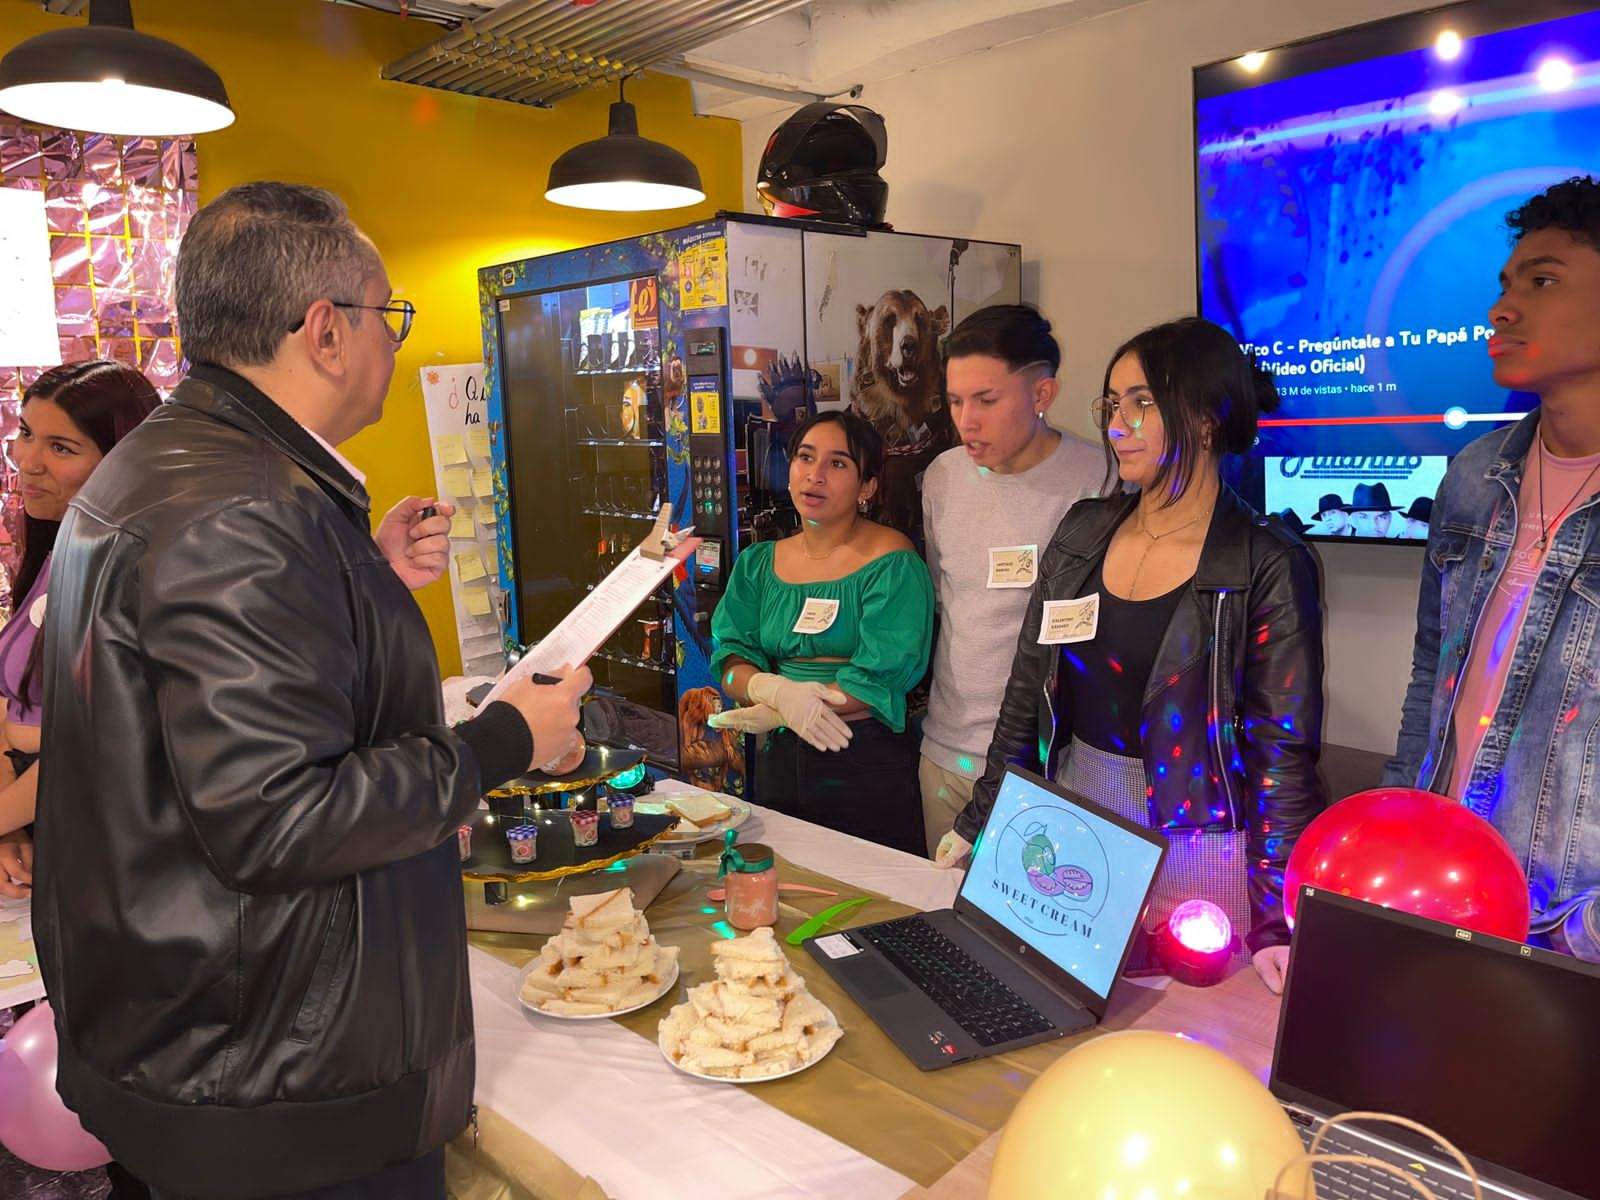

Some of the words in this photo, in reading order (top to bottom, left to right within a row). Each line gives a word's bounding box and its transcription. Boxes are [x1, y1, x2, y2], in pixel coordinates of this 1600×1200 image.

[1273, 340, 1284, 355] C
[1299, 333, 1381, 355] Pregúntale
[1385, 336, 1395, 348] a
[1399, 330, 1421, 346] Tu
[1426, 326, 1468, 346] Papá
[1310, 354, 1366, 375] Oficial)
[1289, 386, 1299, 396] M
[1300, 385, 1313, 395] de
[1314, 383, 1343, 394] vistas
[1350, 383, 1375, 393] hace
[1377, 382, 1383, 392] 1
[1386, 382, 1397, 392] m
[992, 879, 1039, 910] SWEET
[1040, 903, 1092, 939] CREAM
